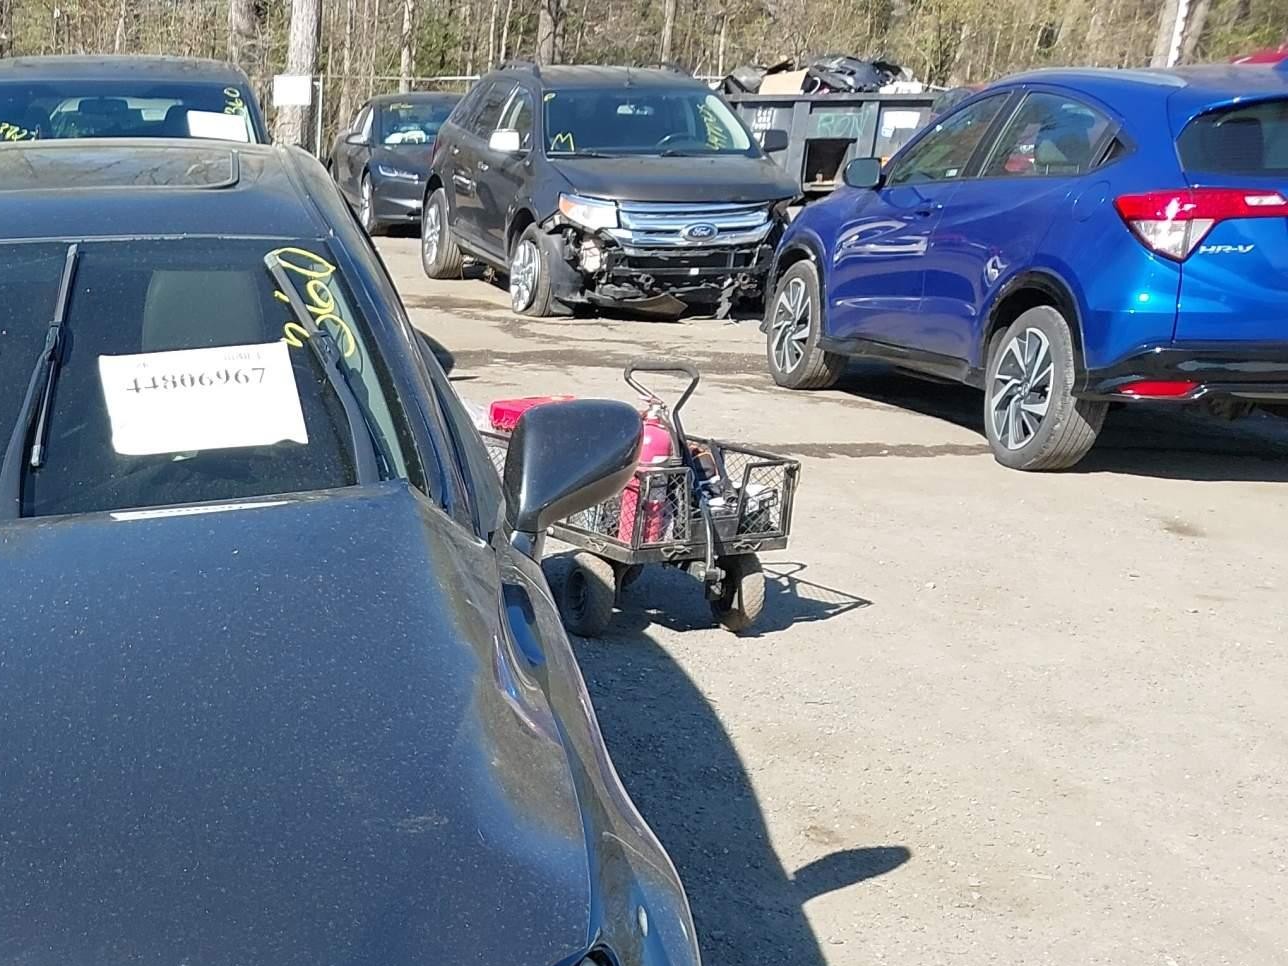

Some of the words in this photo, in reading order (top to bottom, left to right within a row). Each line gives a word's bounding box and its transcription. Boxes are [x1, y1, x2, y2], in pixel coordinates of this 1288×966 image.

[551, 132, 575, 152] M
[1199, 244, 1255, 254] HR-V
[126, 367, 266, 393] 44806967
